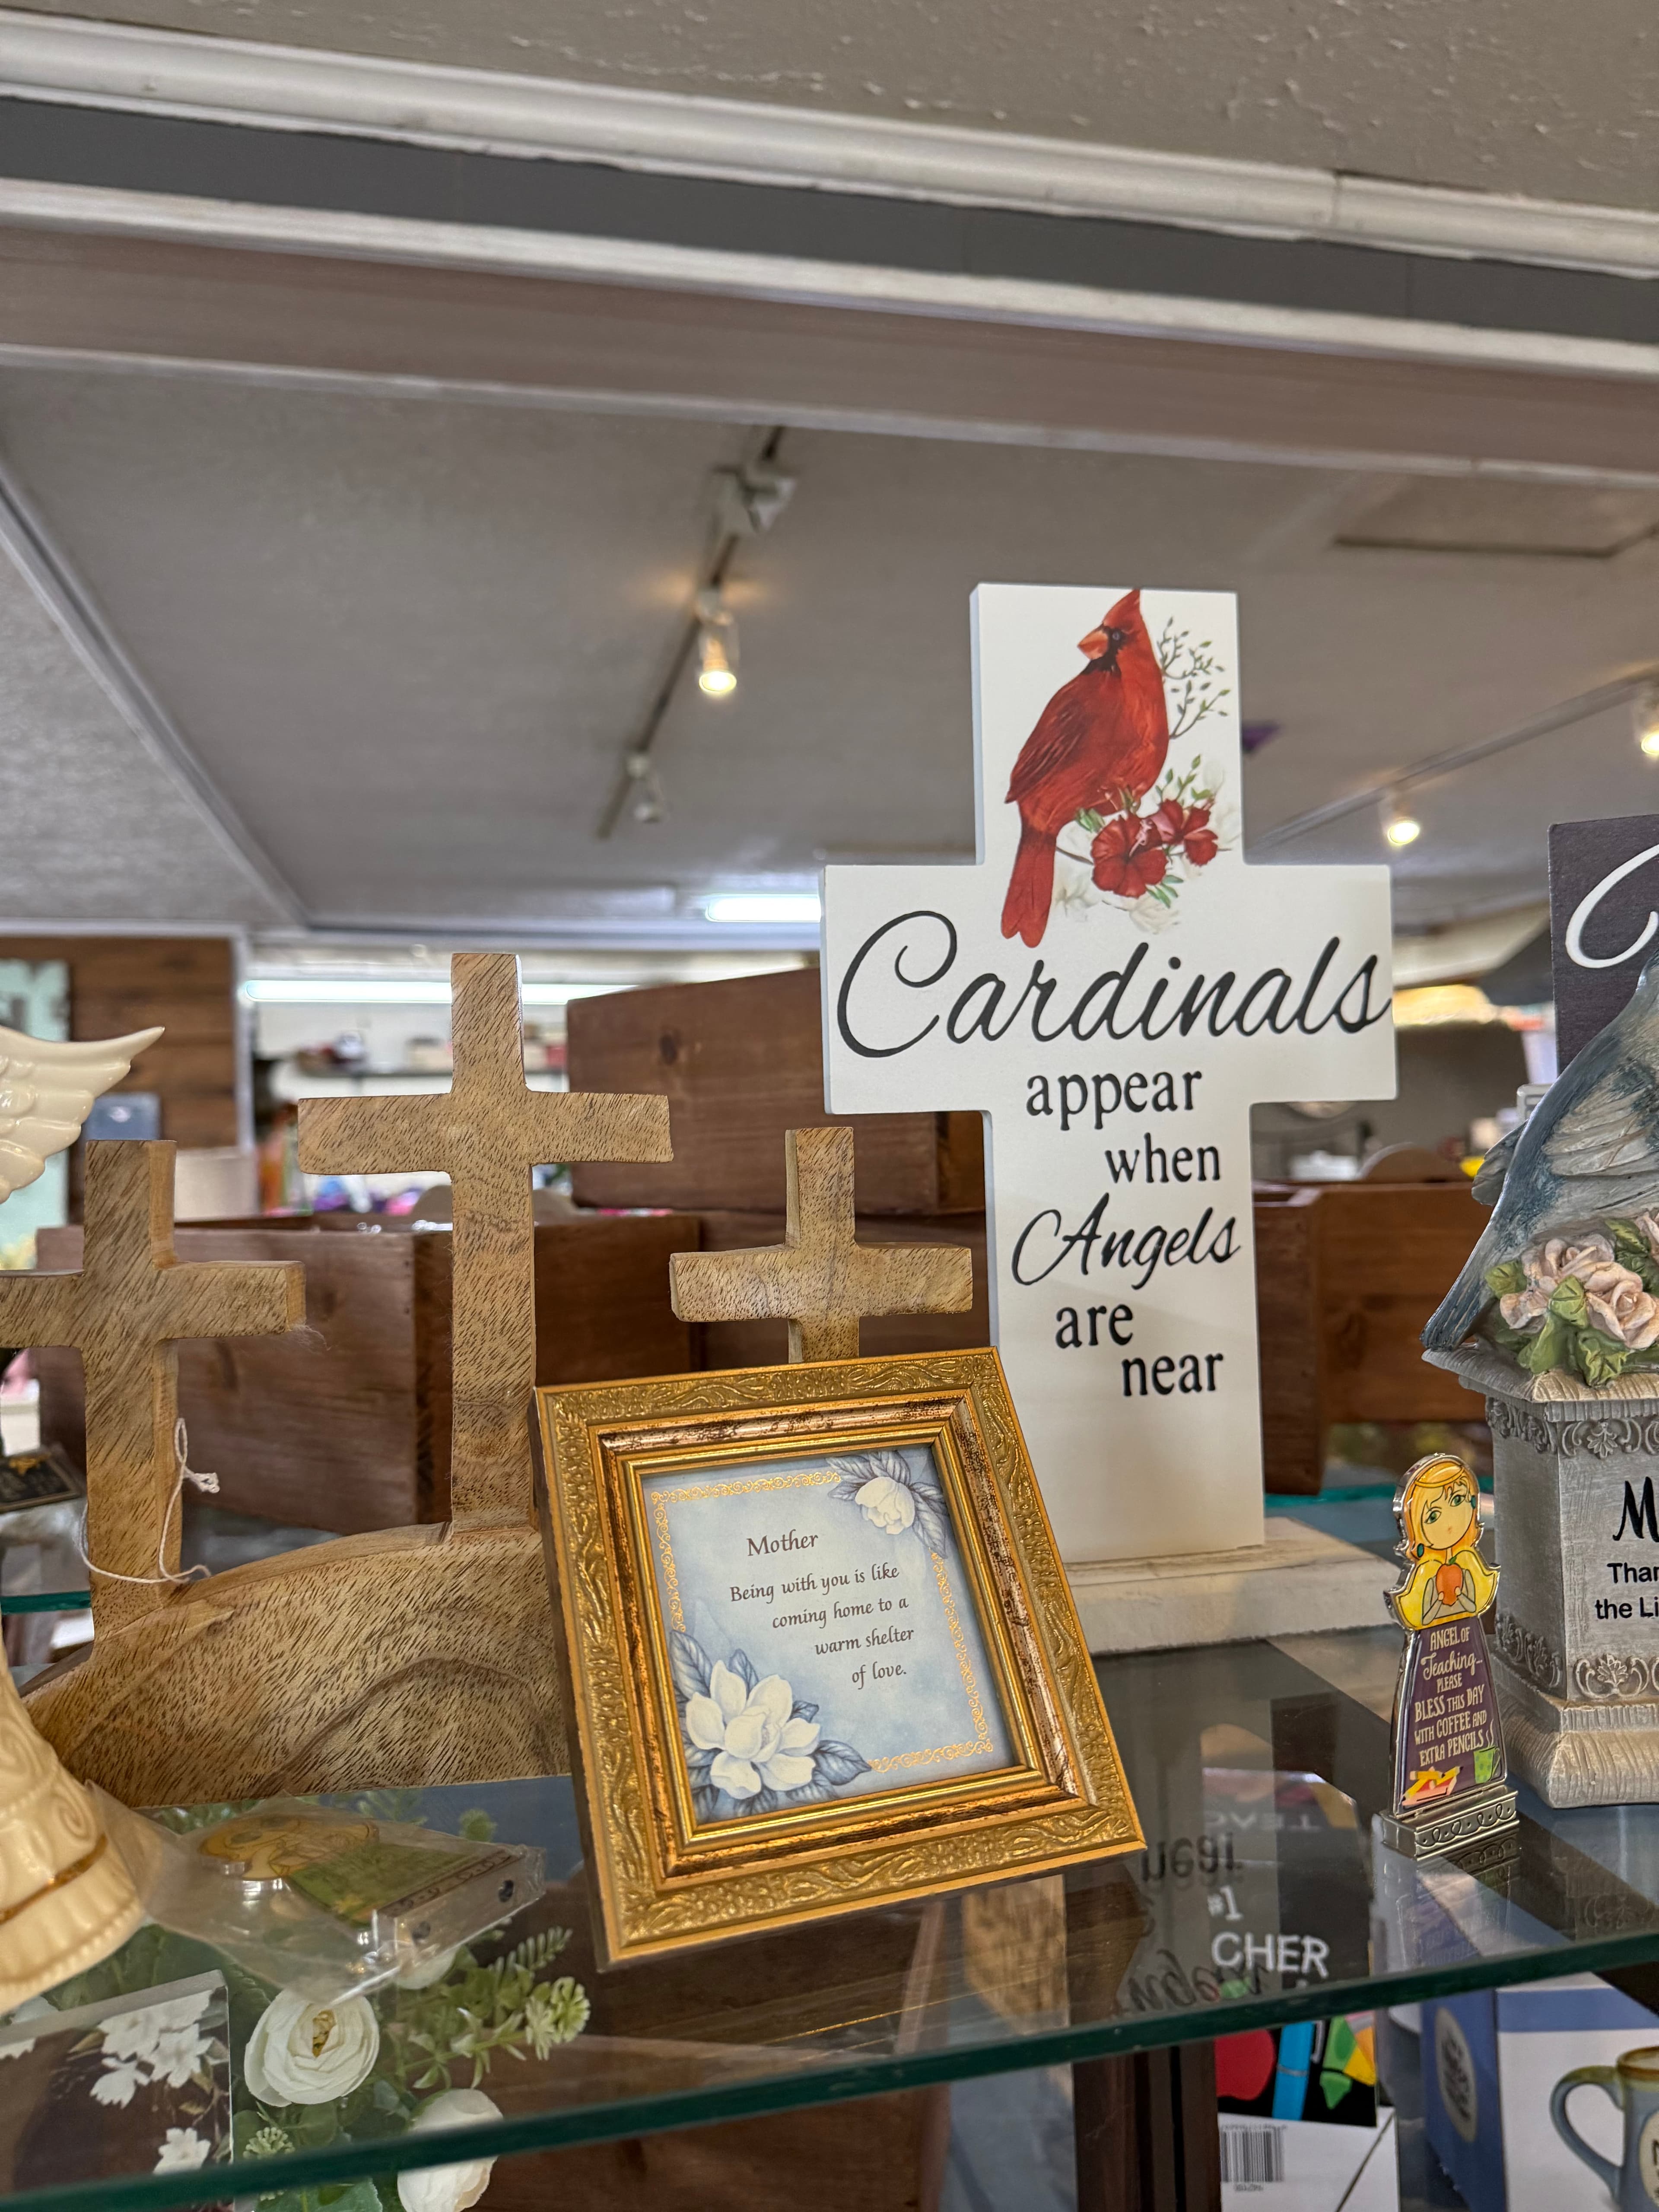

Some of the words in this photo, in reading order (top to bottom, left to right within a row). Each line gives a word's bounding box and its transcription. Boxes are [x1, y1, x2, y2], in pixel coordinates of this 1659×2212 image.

[837, 910, 1392, 1058] Cardinals
[1026, 1071, 1202, 1131] appear
[1104, 1132, 1221, 1184] when
[1011, 1192, 1241, 1290] Angels
[1055, 1303, 1134, 1350] are
[1121, 1353, 1224, 1398] near
[746, 1529, 819, 1556] Mother
[730, 1584, 774, 1604] Being
[781, 1573, 818, 1594] with
[821, 1575, 850, 1595] you
[854, 1569, 865, 1583] is
[871, 1562, 900, 1581] like
[772, 1608, 827, 1629] coming
[833, 1601, 874, 1619] home
[877, 1598, 893, 1612] to
[898, 1598, 909, 1609] a
[1595, 1598, 1633, 1619] the
[814, 1638, 862, 1655] warm
[865, 1625, 915, 1647] shelter
[1430, 1626, 1460, 1651] ANGEL
[1460, 1626, 1471, 1643] OF
[852, 1664, 867, 1690] of
[872, 1661, 907, 1680] love.
[1436, 1672, 1463, 1694] PLEASE
[1414, 1694, 1446, 1723] BLESS
[1446, 1694, 1465, 1713] THIS
[1466, 1684, 1485, 1707] DAY
[1414, 1725, 1435, 1745] WITH
[1436, 1711, 1471, 1738] COFFEE
[1472, 1709, 1487, 1728] AND
[1419, 1743, 1446, 1767] EXTRA
[1447, 1729, 1484, 1758] PENCILS
[1211, 1931, 1330, 1978] CHER
